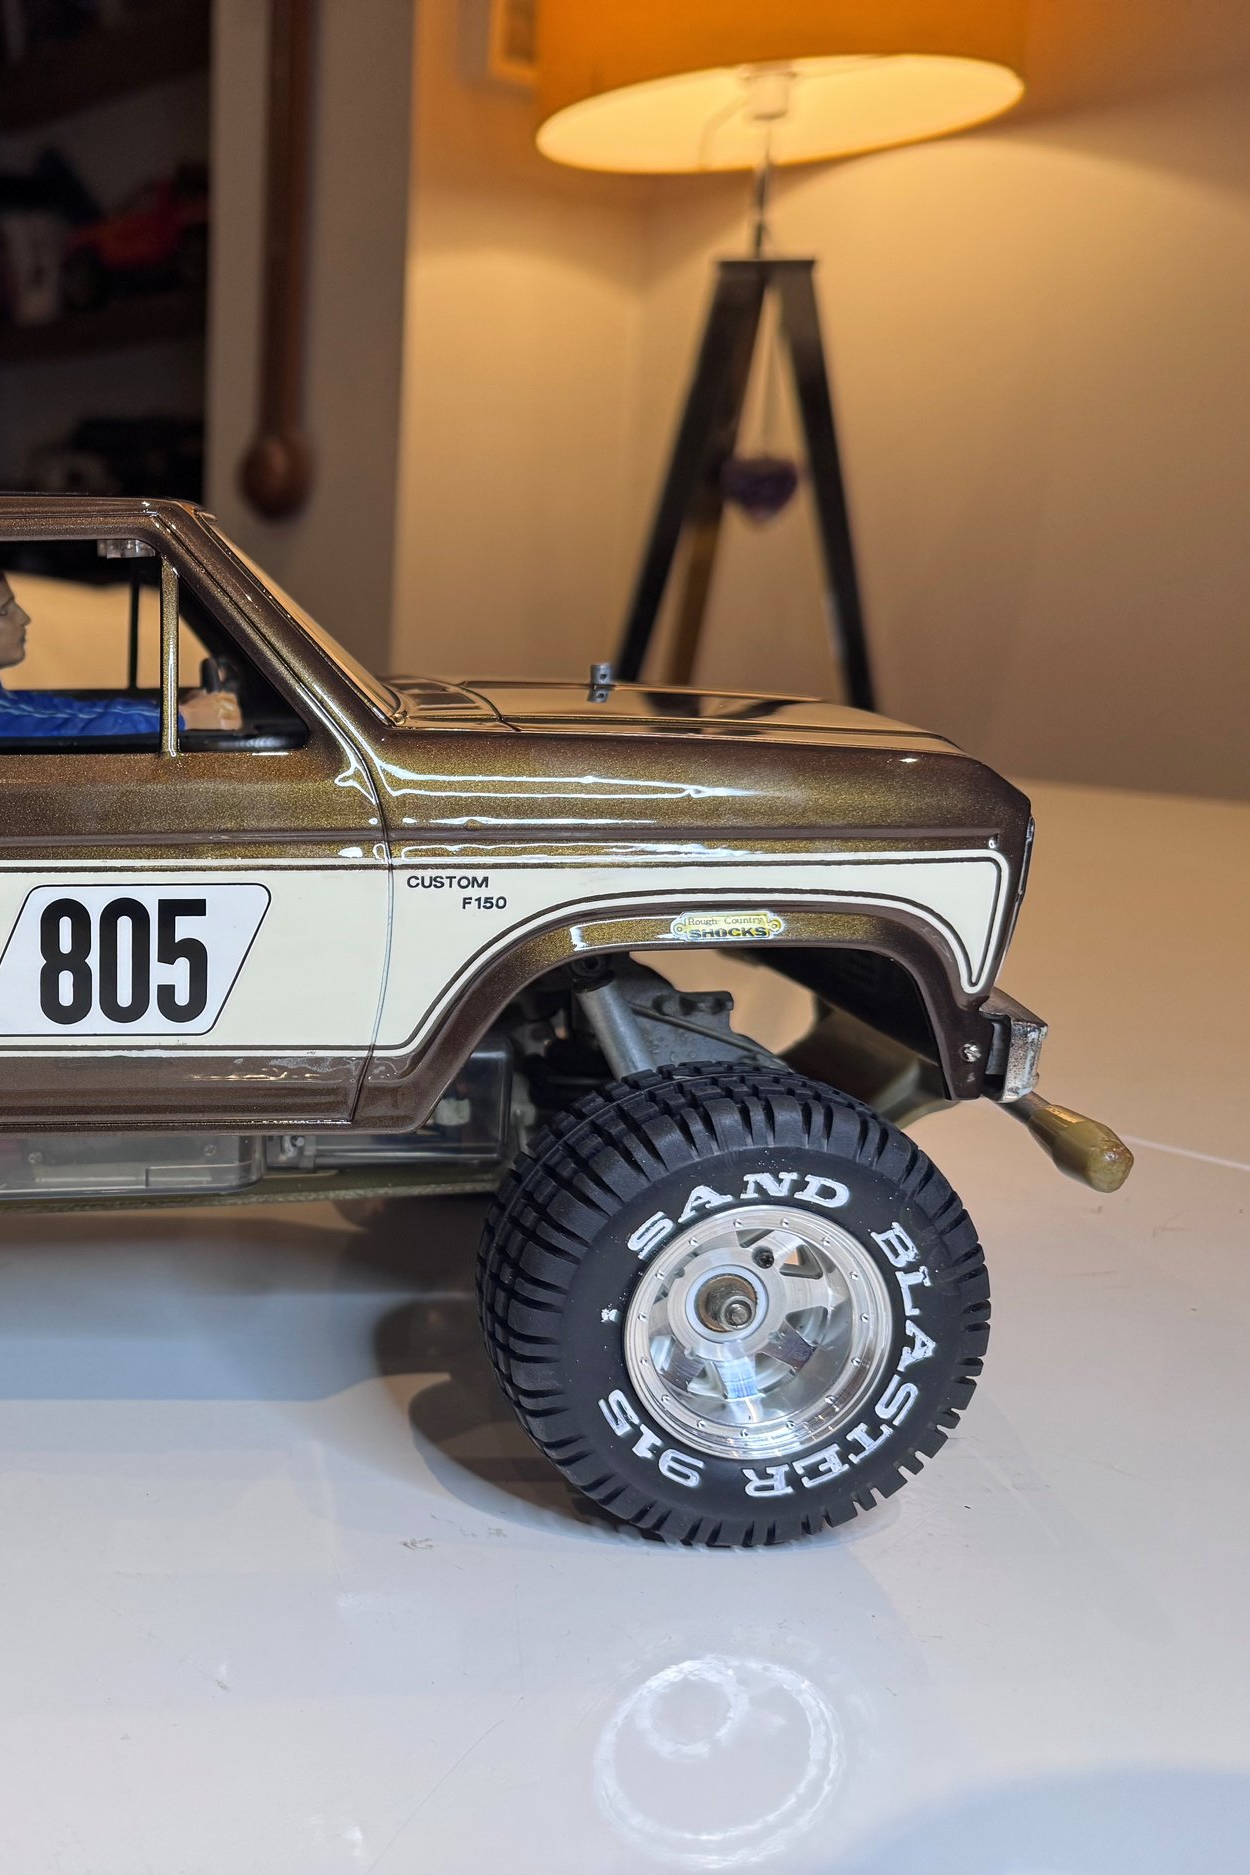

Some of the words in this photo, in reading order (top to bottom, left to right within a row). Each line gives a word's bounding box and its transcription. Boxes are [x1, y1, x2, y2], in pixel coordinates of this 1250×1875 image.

[406, 875, 489, 889] CUSTOM
[462, 896, 507, 910] F150
[688, 917, 718, 926] Rough
[690, 927, 768, 938] SHOCKS
[39, 897, 208, 1024] 805
[627, 1171, 851, 1259] SAND
[745, 1221, 938, 1498] BLASTER
[598, 1389, 707, 1489] 915
